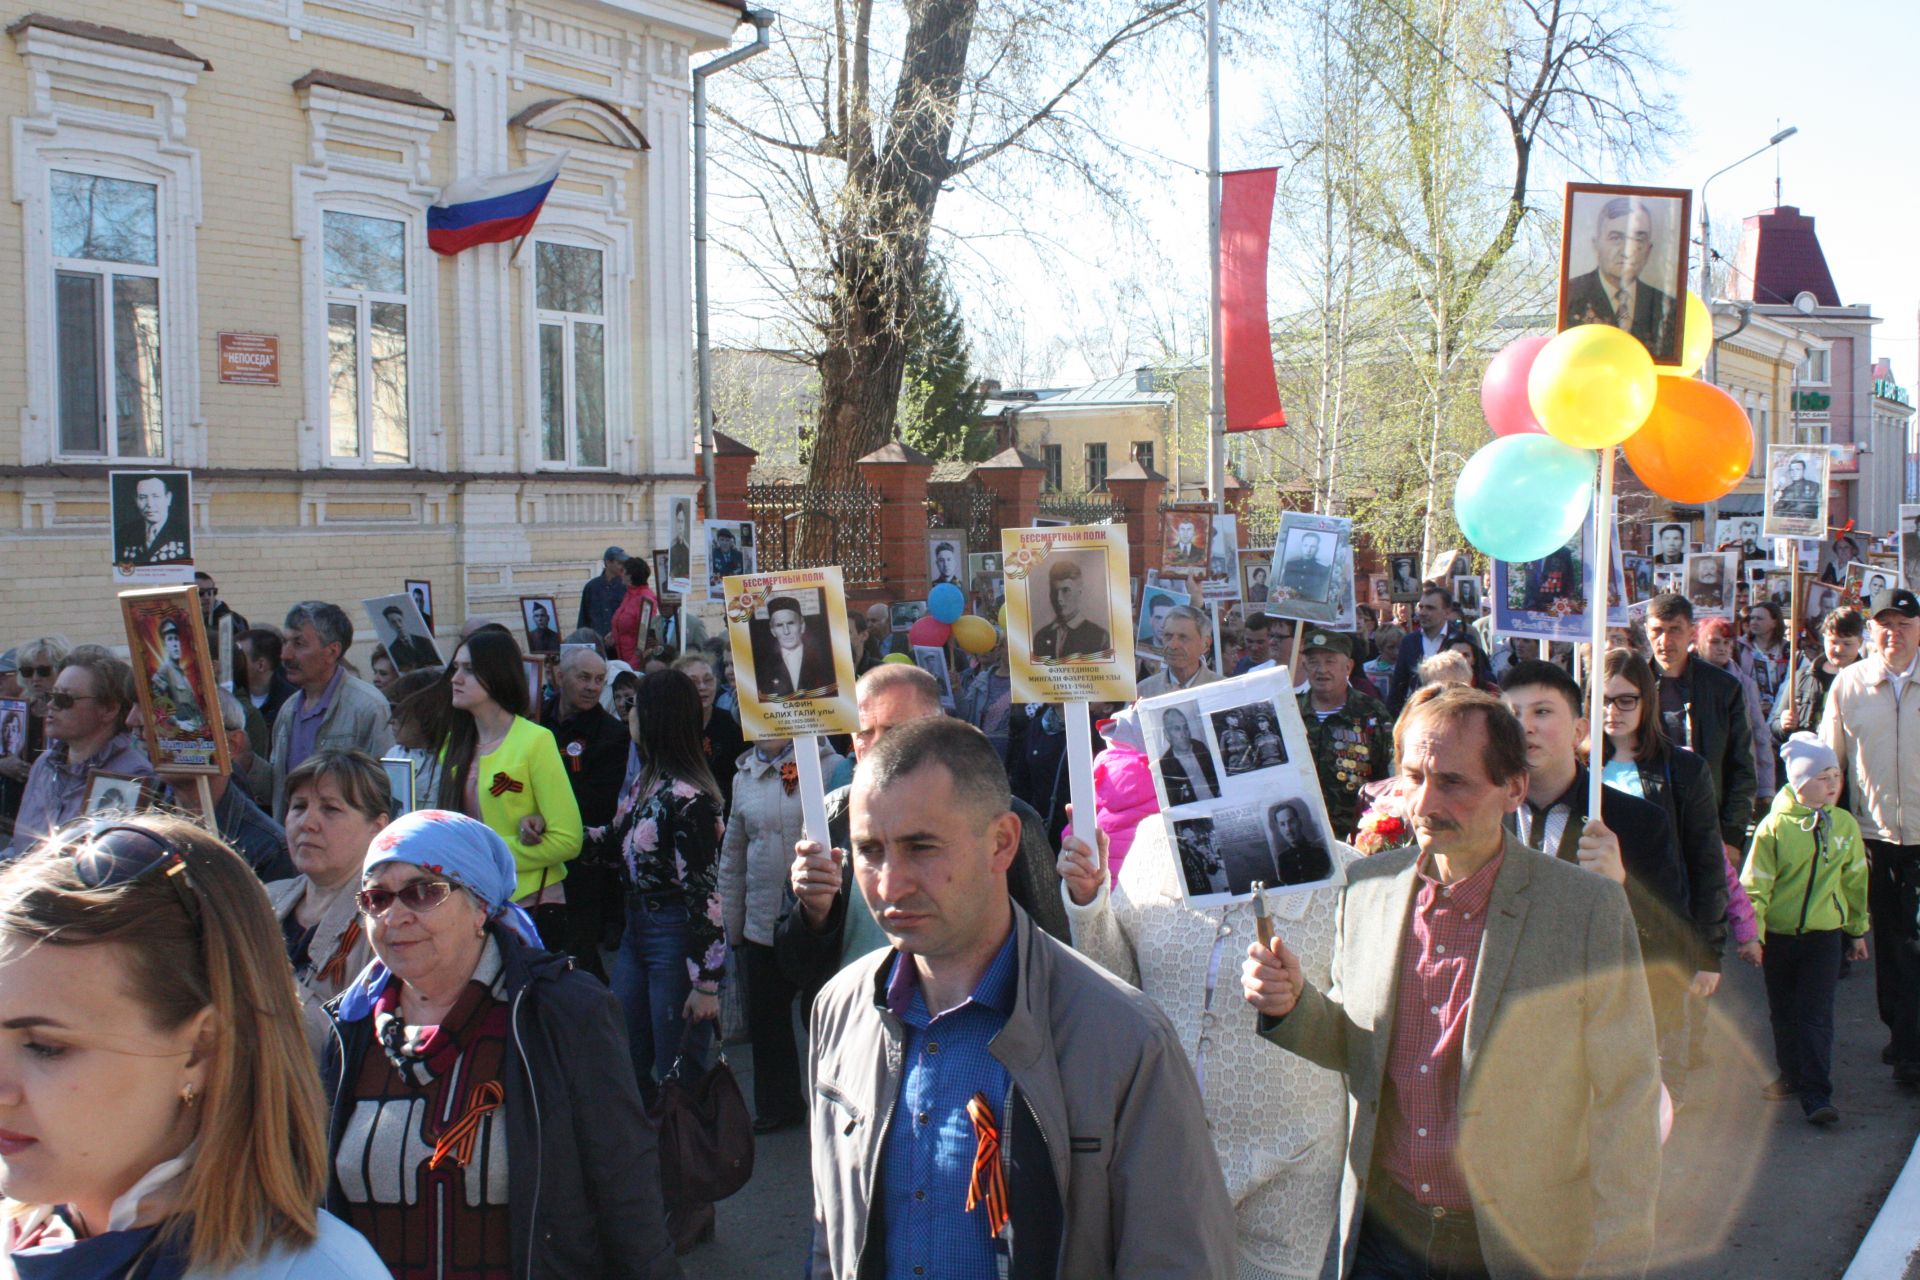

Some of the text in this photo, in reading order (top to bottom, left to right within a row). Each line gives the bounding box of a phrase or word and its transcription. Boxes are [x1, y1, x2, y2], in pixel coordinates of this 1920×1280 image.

[1020, 530, 1106, 543] БЕССМЕРТНЫЙ ПОЛК
[743, 572, 825, 588] БЕССМЕРТНЫЙ ПОЛК
[782, 701, 813, 709] САФИН
[763, 709, 835, 720] САЛИХ ГАЛИ улы
